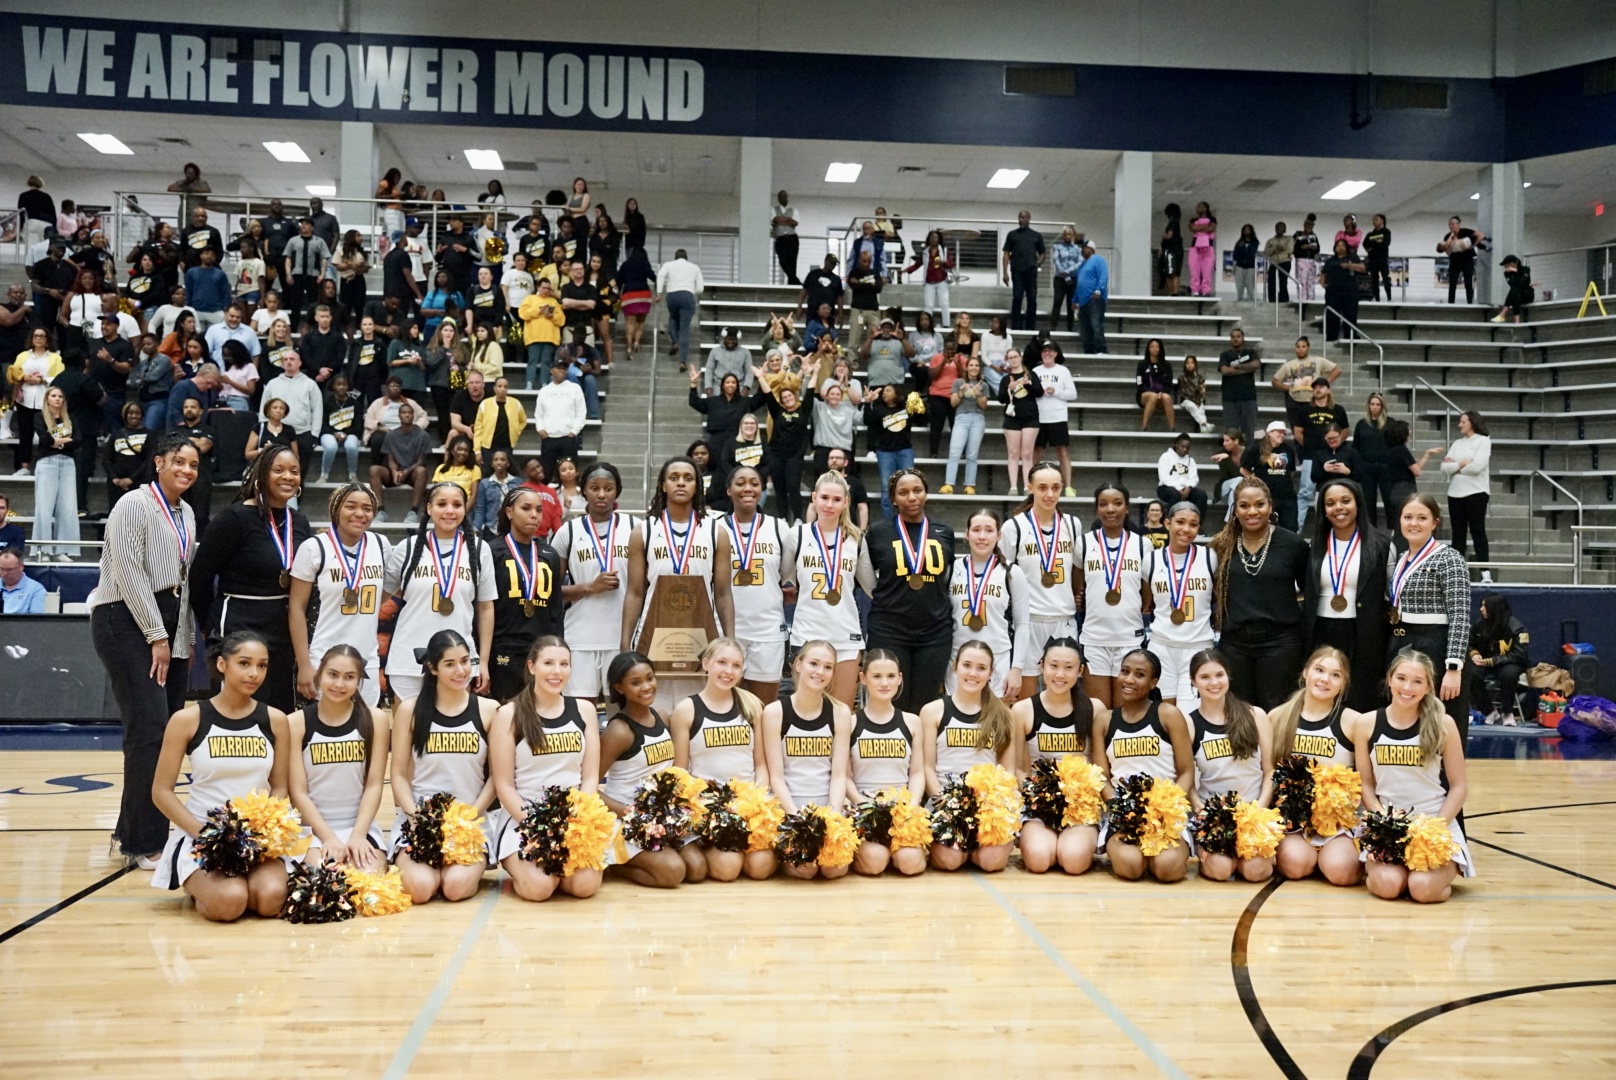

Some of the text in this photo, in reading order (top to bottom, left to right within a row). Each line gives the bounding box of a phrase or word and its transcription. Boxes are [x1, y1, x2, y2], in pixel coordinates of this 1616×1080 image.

[22, 25, 705, 122] WE ARE FLOWER MOUND
[208, 735, 268, 758] WARRIORS
[426, 731, 480, 754] WARRIORS
[703, 724, 752, 749] WARRIORS
[785, 735, 834, 757] WARRIORS
[858, 737, 907, 759] WARRIORS
[946, 727, 995, 750] WARRIS
[1113, 735, 1160, 758] WARRIORS
[1292, 733, 1337, 758] ARRIORS
[310, 739, 366, 765] WARRIORS
[644, 738, 675, 766] WARRIO
[1202, 737, 1235, 761] WARR
